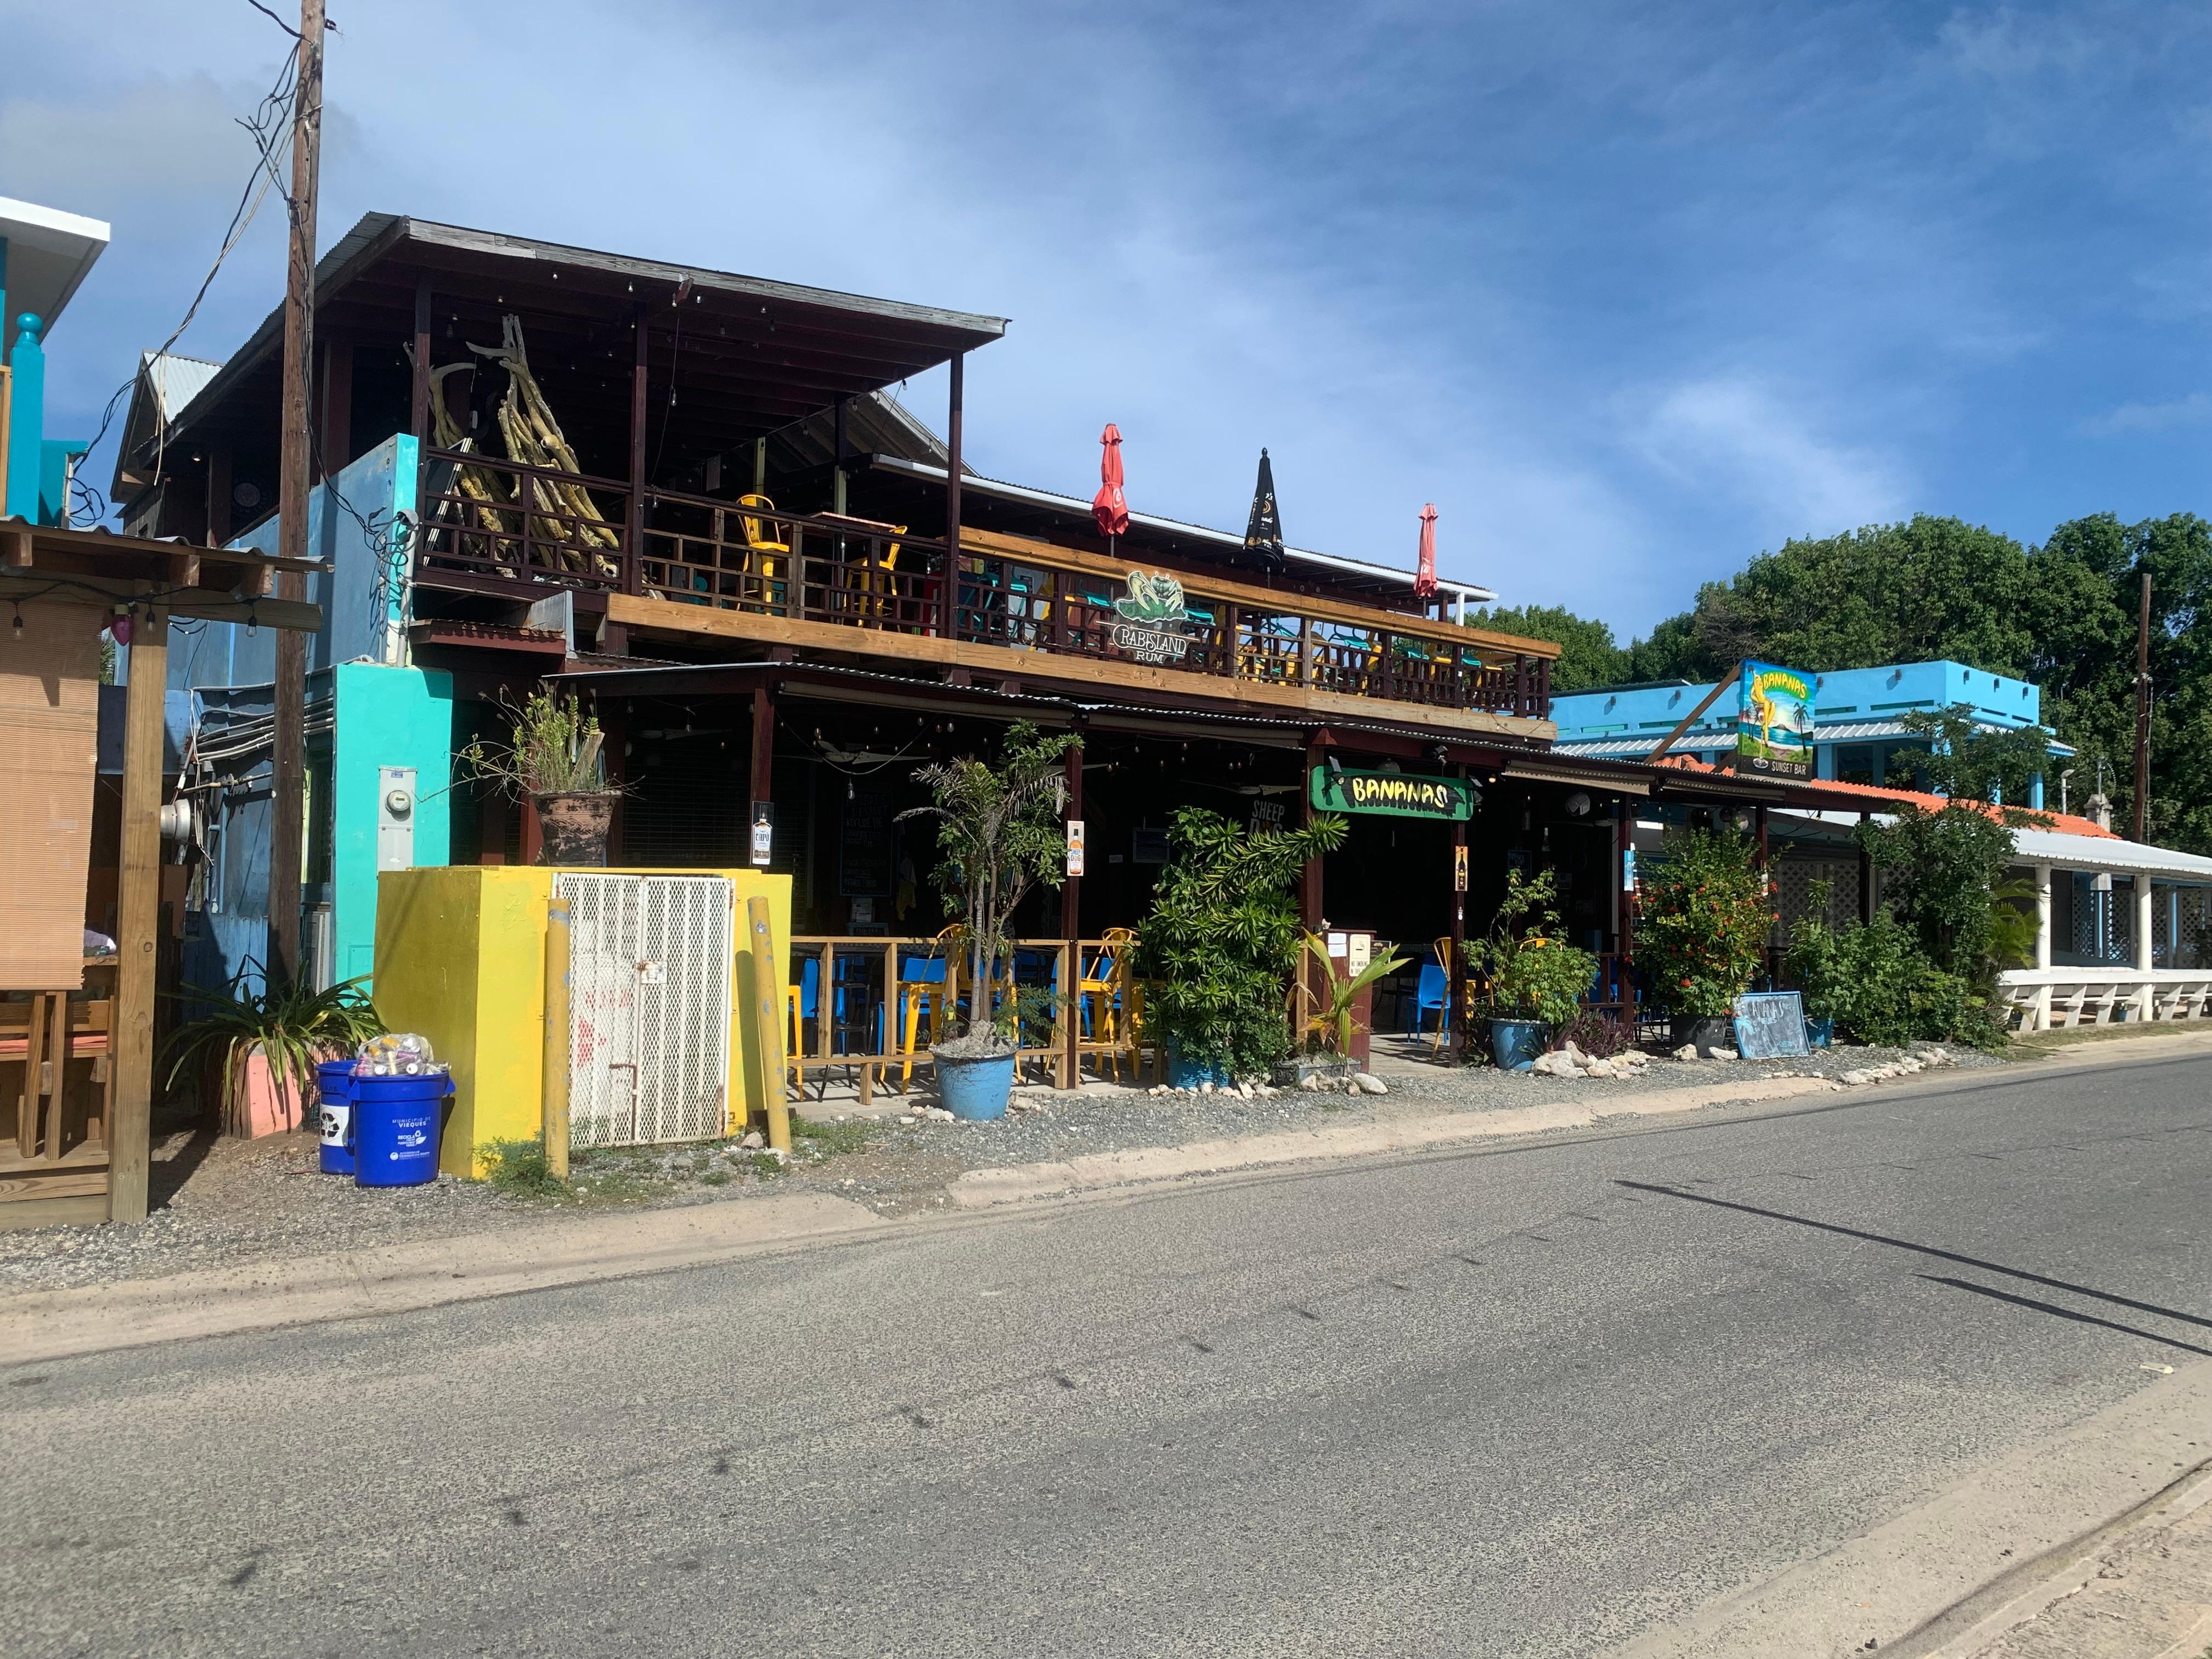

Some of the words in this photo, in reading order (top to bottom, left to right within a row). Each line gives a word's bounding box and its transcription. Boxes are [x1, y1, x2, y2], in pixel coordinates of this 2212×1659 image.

[1136, 651, 1164, 663] RUM
[1763, 673, 1807, 698] BANANAS
[1771, 761, 1793, 773] SUNSET
[1794, 764, 1806, 775] BAR
[1352, 777, 1448, 808] BANANAS
[1251, 799, 1285, 822] SHEEP
